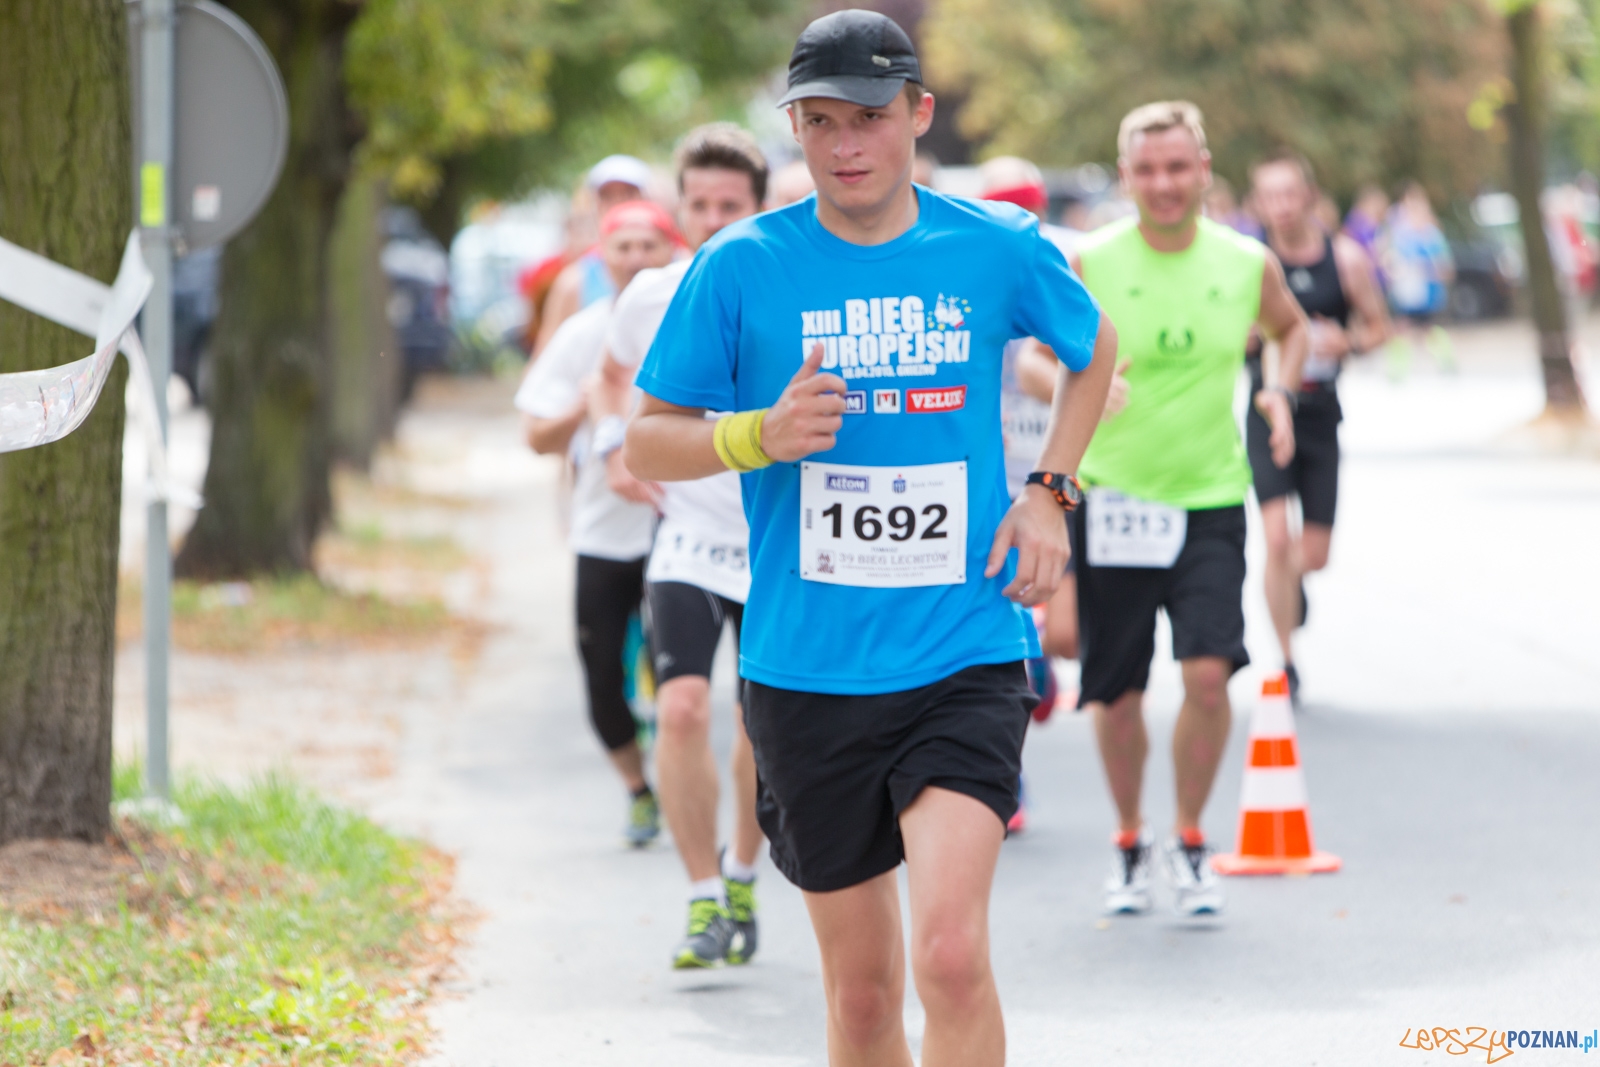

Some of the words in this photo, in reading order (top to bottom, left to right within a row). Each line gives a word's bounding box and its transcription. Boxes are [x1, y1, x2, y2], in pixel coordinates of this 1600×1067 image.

[801, 309, 842, 336] XIII
[845, 295, 925, 336] BIEG
[911, 390, 963, 409] VELUX
[822, 502, 948, 541] 1692
[839, 552, 855, 564] 39
[858, 554, 887, 566] BIEG
